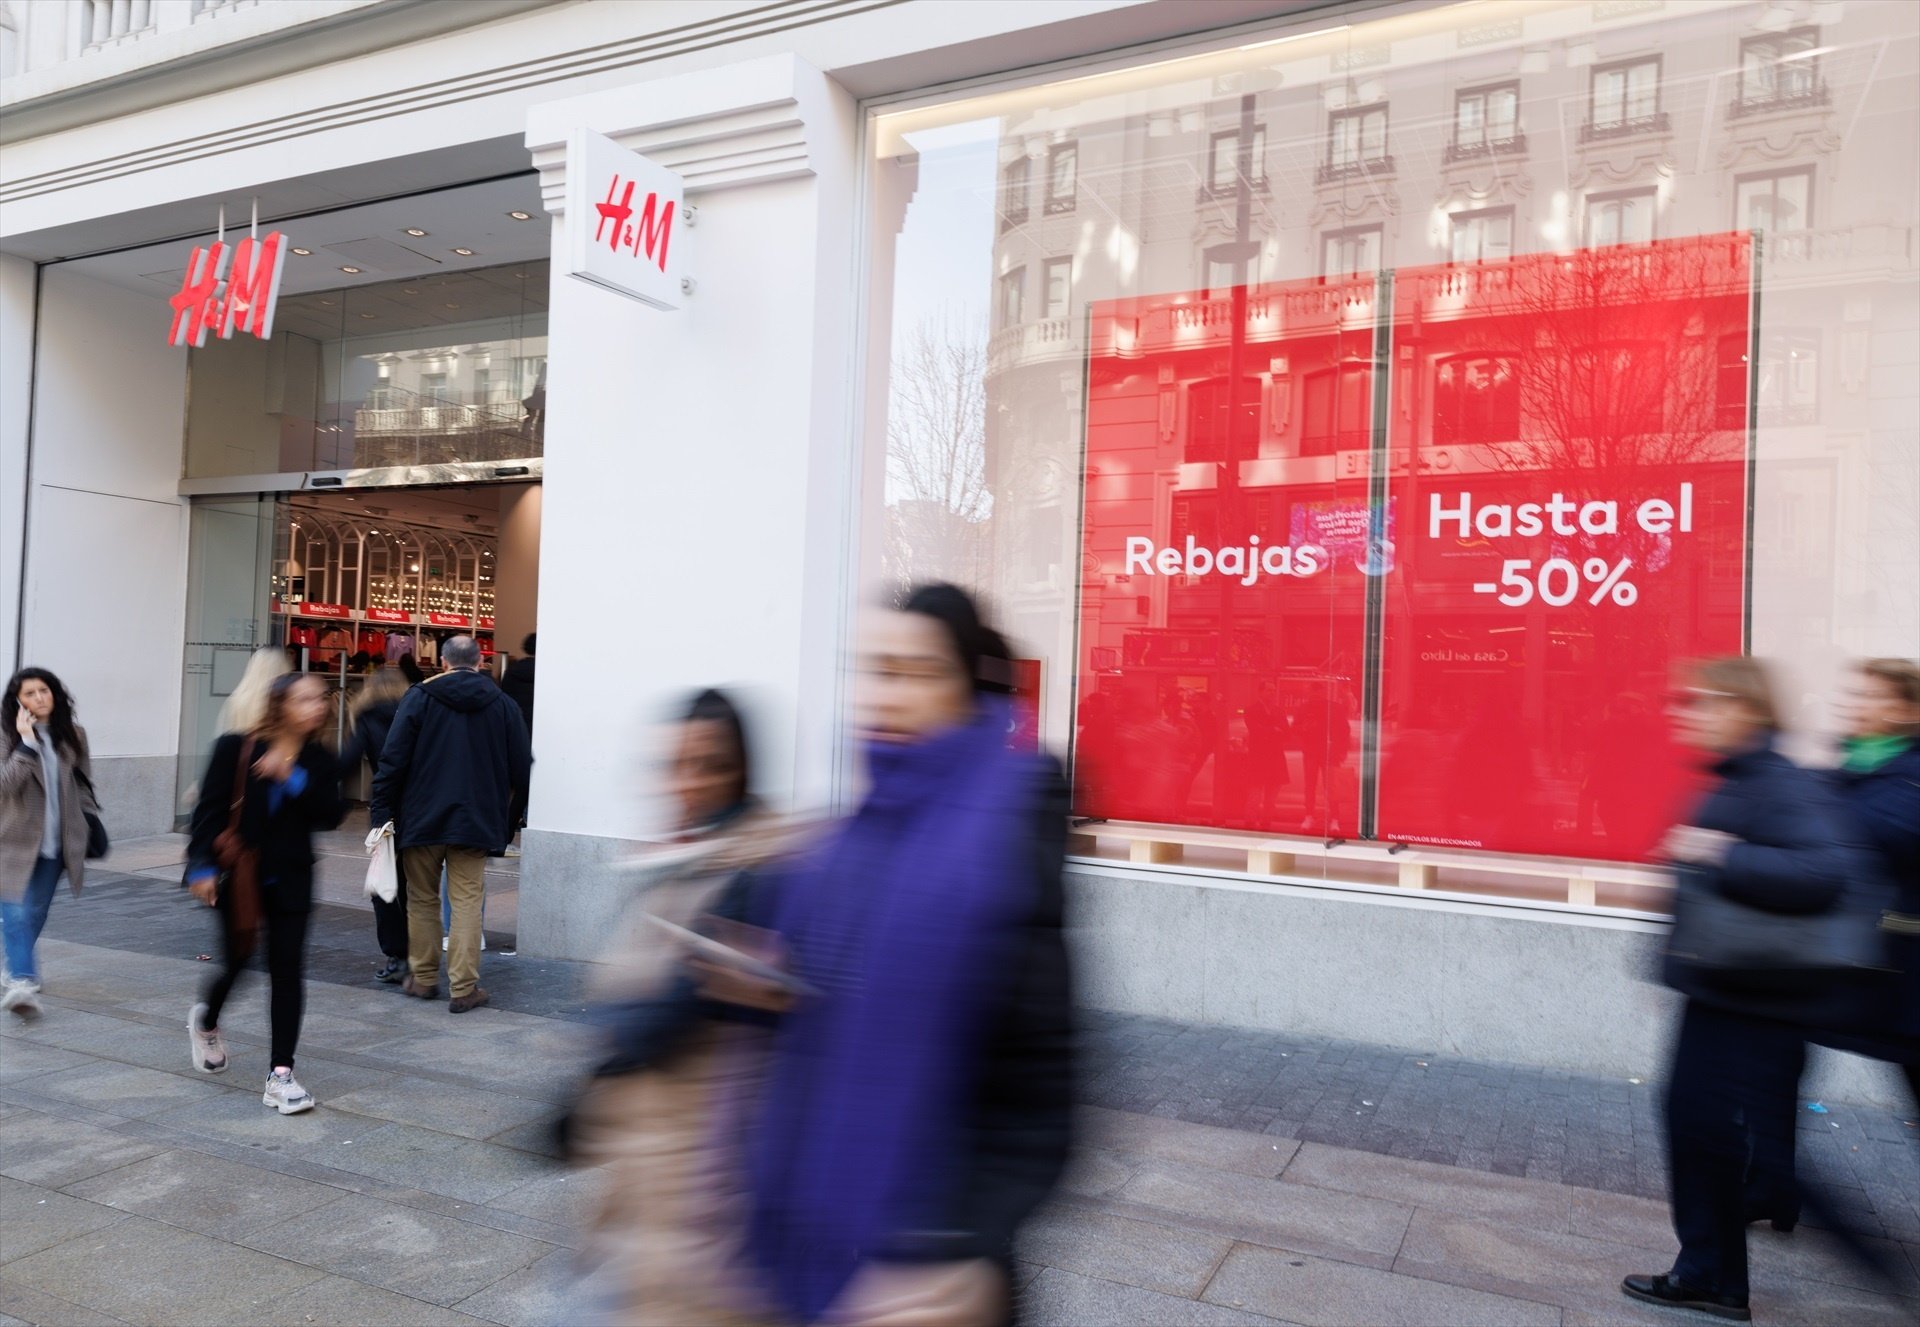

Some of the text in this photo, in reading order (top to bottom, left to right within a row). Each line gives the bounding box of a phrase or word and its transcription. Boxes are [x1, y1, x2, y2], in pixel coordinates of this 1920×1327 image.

[595, 173, 675, 274] H&M
[168, 230, 286, 347] H&M
[1429, 483, 1692, 538] Hasta el
[1124, 535, 1318, 586] Rebajas
[1473, 557, 1639, 607] -50%
[309, 604, 341, 615] Rebajas
[375, 609, 402, 620] Rebajas
